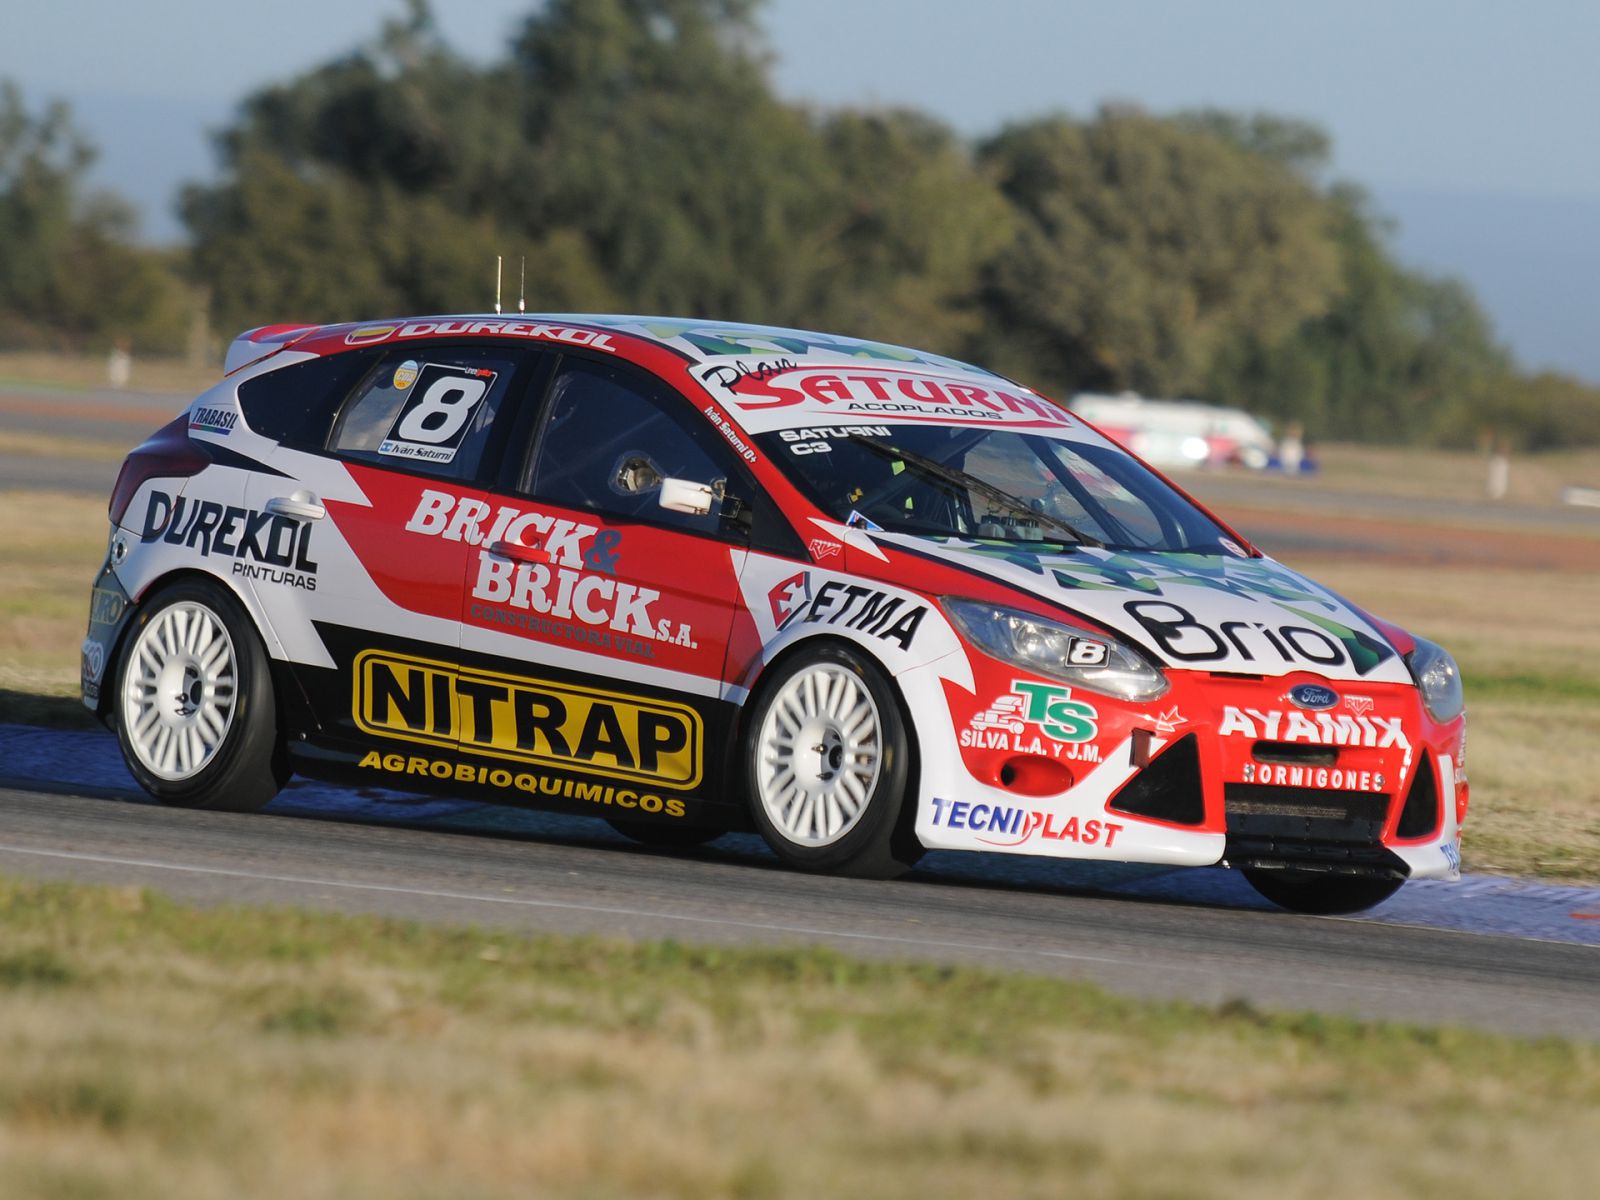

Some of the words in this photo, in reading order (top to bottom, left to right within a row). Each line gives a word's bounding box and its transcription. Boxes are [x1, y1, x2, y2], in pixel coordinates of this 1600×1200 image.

[398, 321, 616, 352] DUREKOL
[701, 358, 797, 396] Plan
[192, 407, 239, 429] TRABASIL
[398, 376, 486, 444] 8
[848, 403, 1003, 419] ACOPLADOS
[790, 441, 832, 455] C3
[141, 490, 318, 574] DUREKOL
[405, 489, 599, 571] BRICK
[232, 562, 317, 591] PINTURAS
[472, 551, 660, 640] BRICK
[656, 618, 699, 650] S.A.
[470, 604, 612, 648] CONSTRUCTORA
[614, 637, 656, 658] VIAL
[803, 580, 928, 652] ETMA
[1123, 600, 1346, 667] Brio
[1070, 641, 1106, 664] 8
[371, 662, 687, 772] NITRAP
[1011, 680, 1098, 743] TS
[1301, 687, 1330, 704] Ford
[960, 728, 1009, 751] SILVA
[1013, 735, 1047, 756] L.A.
[1066, 743, 1103, 763] J.M.
[1218, 706, 1412, 750] AYAMIX
[358, 751, 686, 818] AGROBIOQUIMICOS
